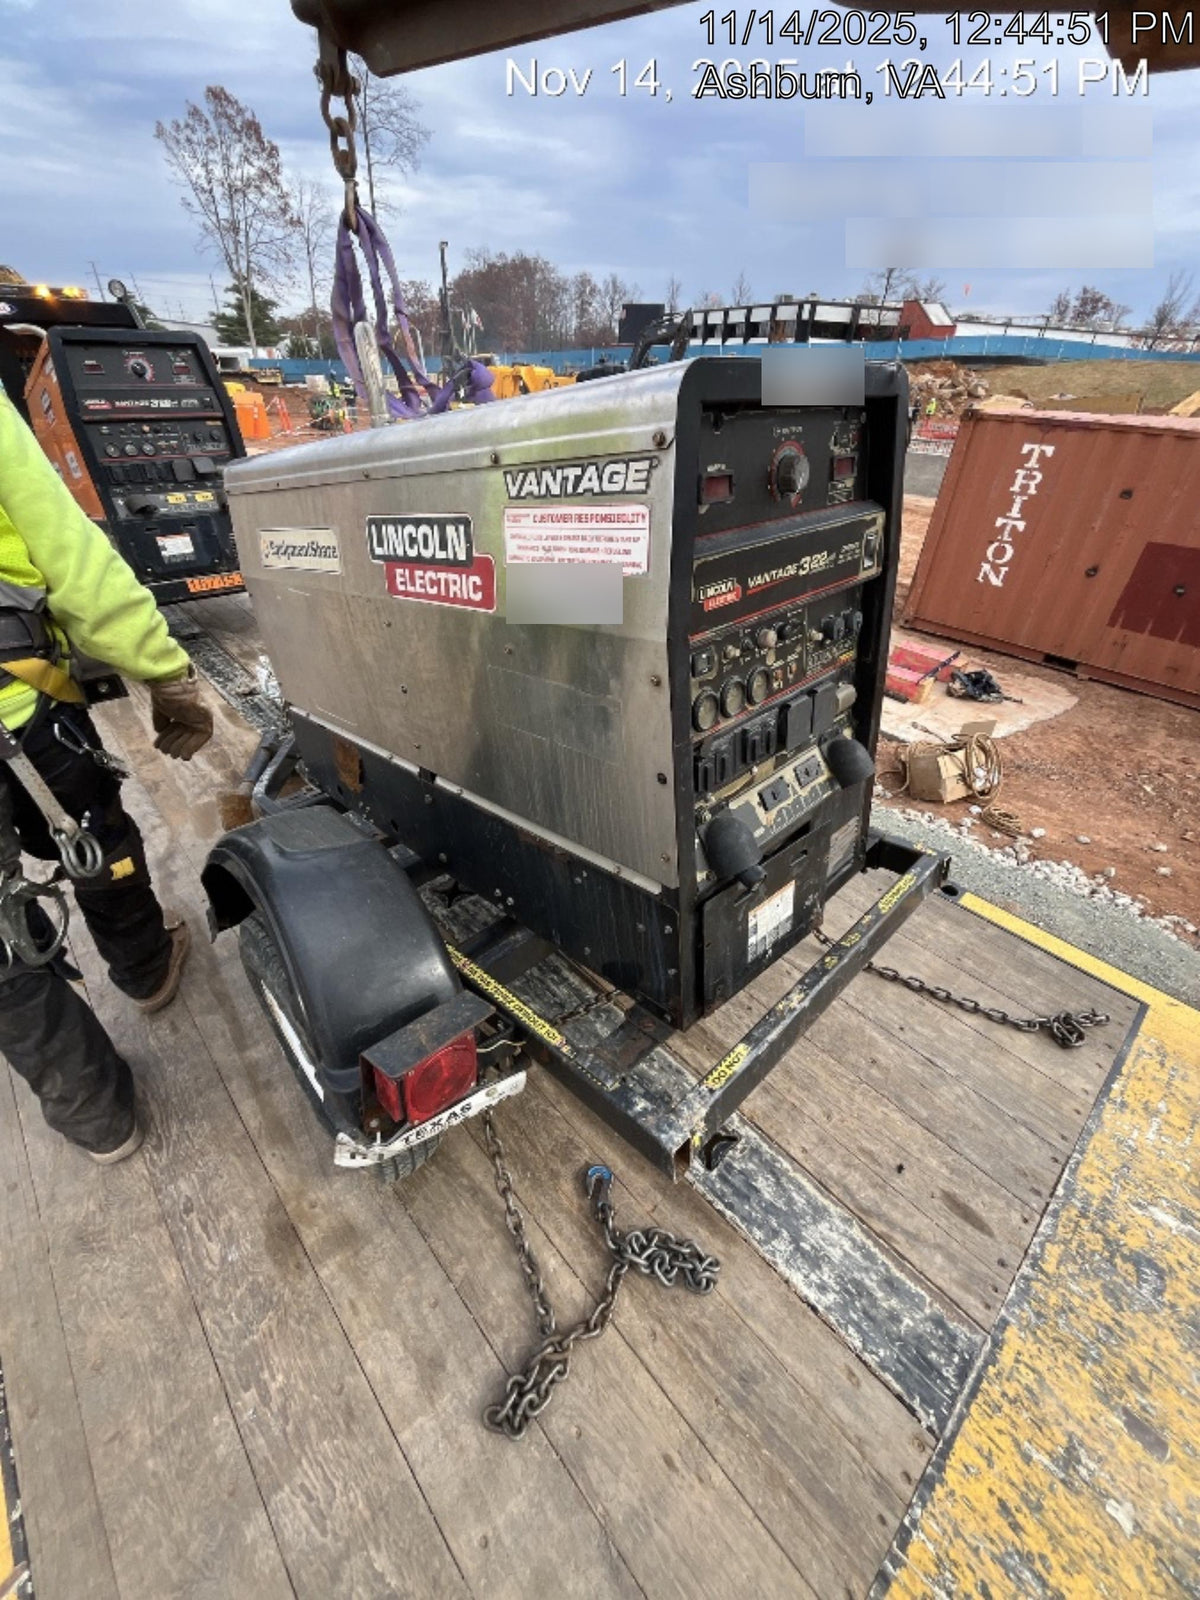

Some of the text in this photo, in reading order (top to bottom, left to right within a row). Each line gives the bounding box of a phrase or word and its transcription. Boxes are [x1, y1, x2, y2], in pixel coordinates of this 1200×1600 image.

[503, 457, 652, 500] VANTAGE
[976, 443, 1056, 588] TRITON
[369, 522, 468, 561] LINCOLN
[394, 567, 483, 601] ELECTRIC
[748, 564, 799, 588] VANTAGE
[799, 550, 829, 576] 322
[711, 1069, 728, 1085] DO
[402, 1101, 474, 1146] TEXAS
